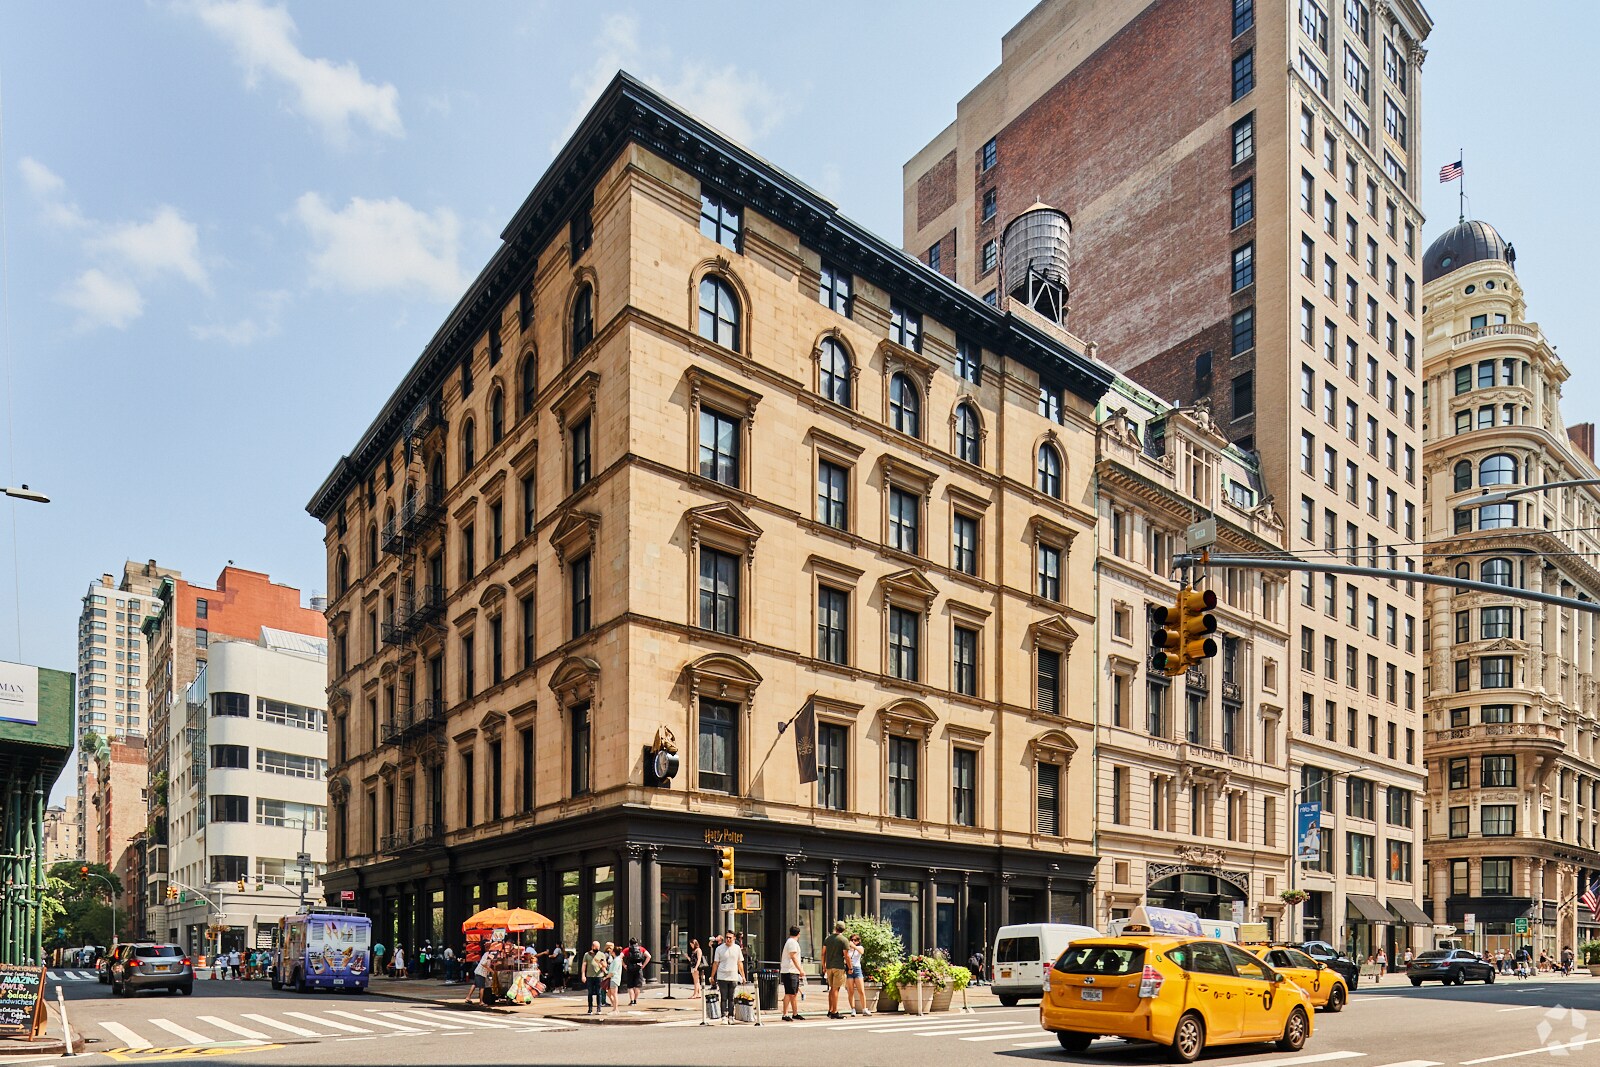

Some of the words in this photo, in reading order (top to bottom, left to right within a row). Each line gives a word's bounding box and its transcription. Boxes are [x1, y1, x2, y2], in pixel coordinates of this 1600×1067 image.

[705, 829, 723, 843] Harry
[724, 829, 743, 843] Potter
[3, 976, 39, 985] AMAZING
[0, 983, 26, 991] OWLS,
